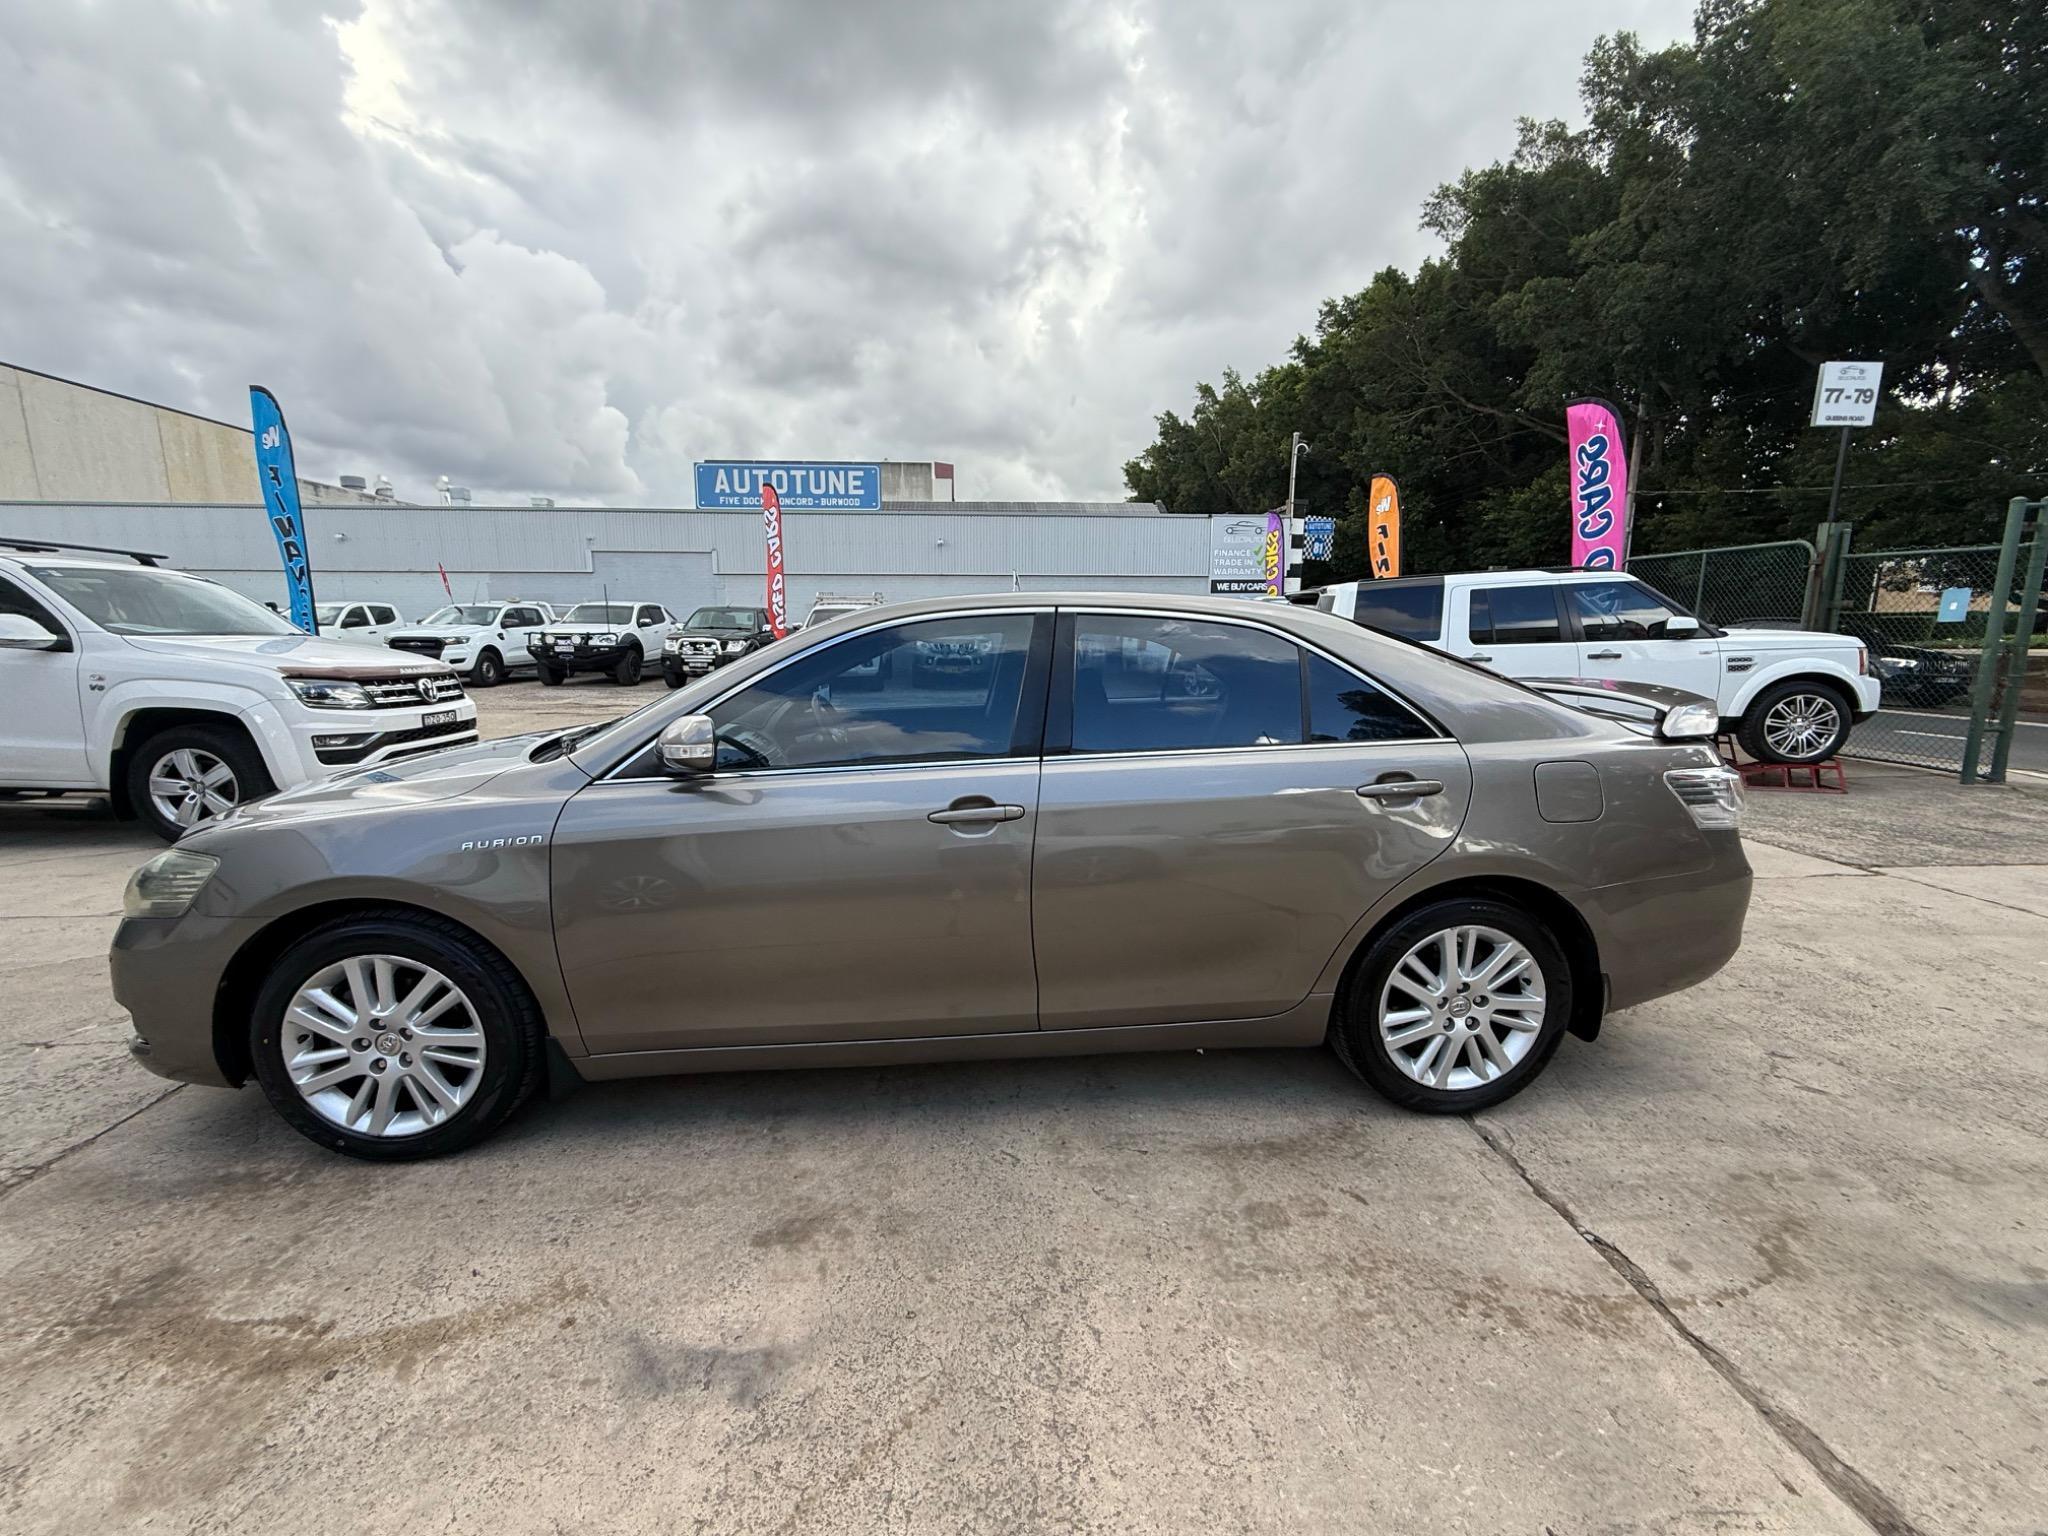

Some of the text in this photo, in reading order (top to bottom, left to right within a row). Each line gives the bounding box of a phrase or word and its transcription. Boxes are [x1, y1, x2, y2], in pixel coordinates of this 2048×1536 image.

[714, 468, 865, 495] AUTOTUNE
[719, 497, 740, 505] FIVE
[778, 497, 814, 506] ONCORD
[820, 498, 861, 506] BURWOOD
[1313, 541, 1324, 555] 81
[1214, 549, 1251, 557] FINANCE
[1214, 558, 1253, 566] TRADE IN
[1216, 582, 1230, 591] WE
[1231, 582, 1247, 591] BUY
[1247, 582, 1268, 591] CARS
[461, 834, 543, 851] AURION
